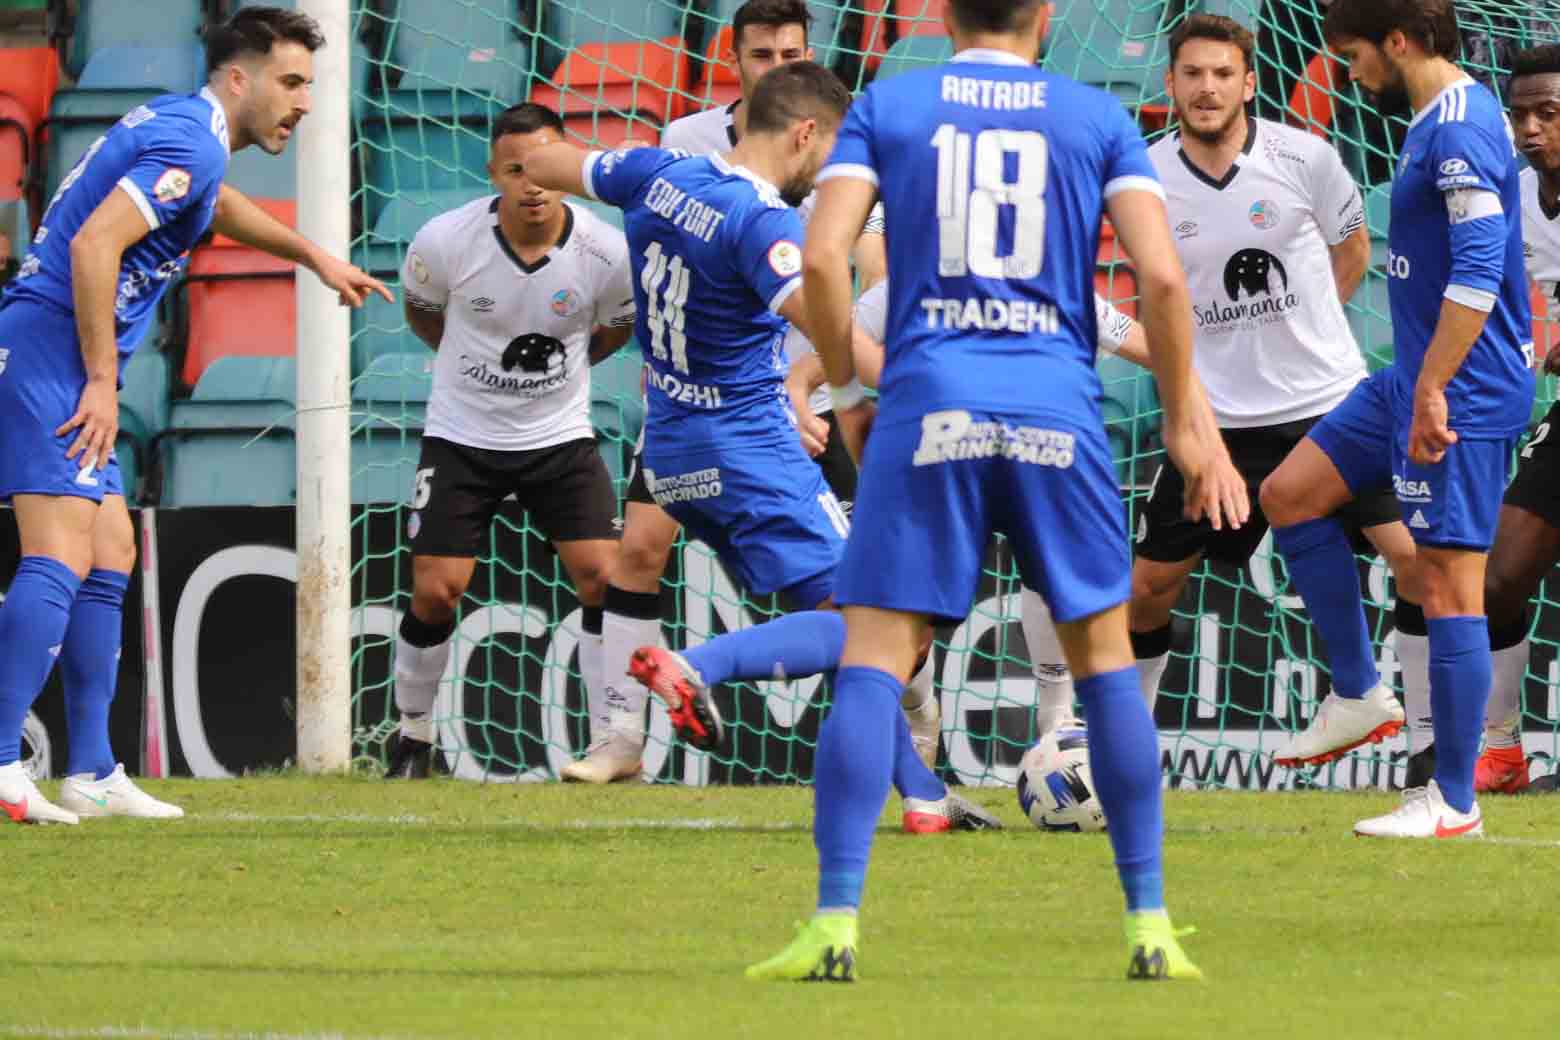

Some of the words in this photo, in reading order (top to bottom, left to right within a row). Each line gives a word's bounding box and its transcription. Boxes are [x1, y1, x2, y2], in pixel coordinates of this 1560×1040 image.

[673, 197, 726, 243] FONT
[930, 123, 1049, 280] 18
[641, 241, 690, 376] 11
[920, 298, 1060, 334] TRADEHI
[1193, 290, 1299, 326] Salamanca
[1520, 422, 1551, 459] 2
